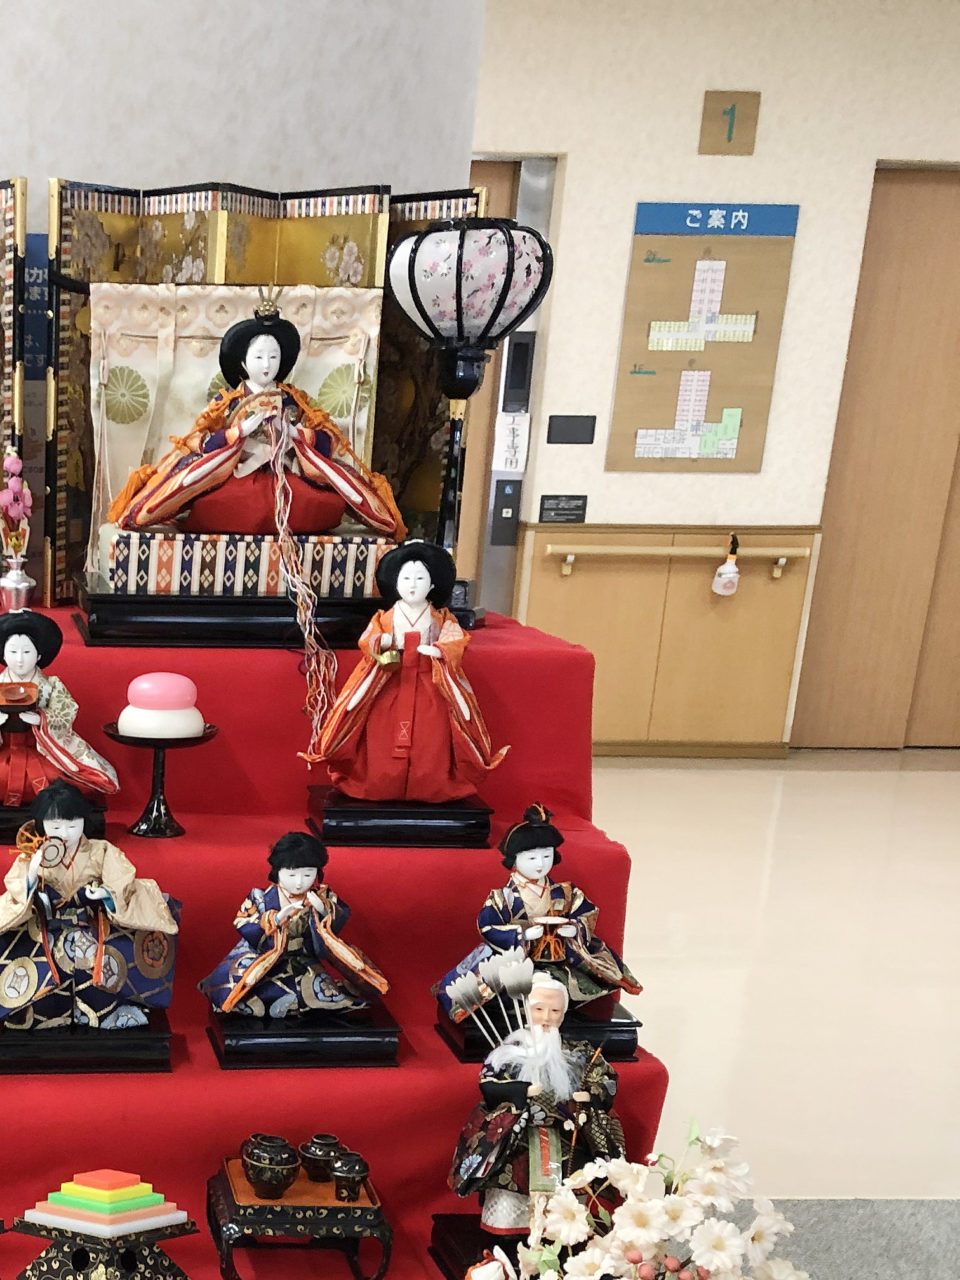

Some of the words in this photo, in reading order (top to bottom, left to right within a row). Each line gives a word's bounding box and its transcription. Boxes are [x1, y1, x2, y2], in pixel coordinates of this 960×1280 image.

[722, 103, 736, 143] 1
[686, 208, 749, 230] ご案内
